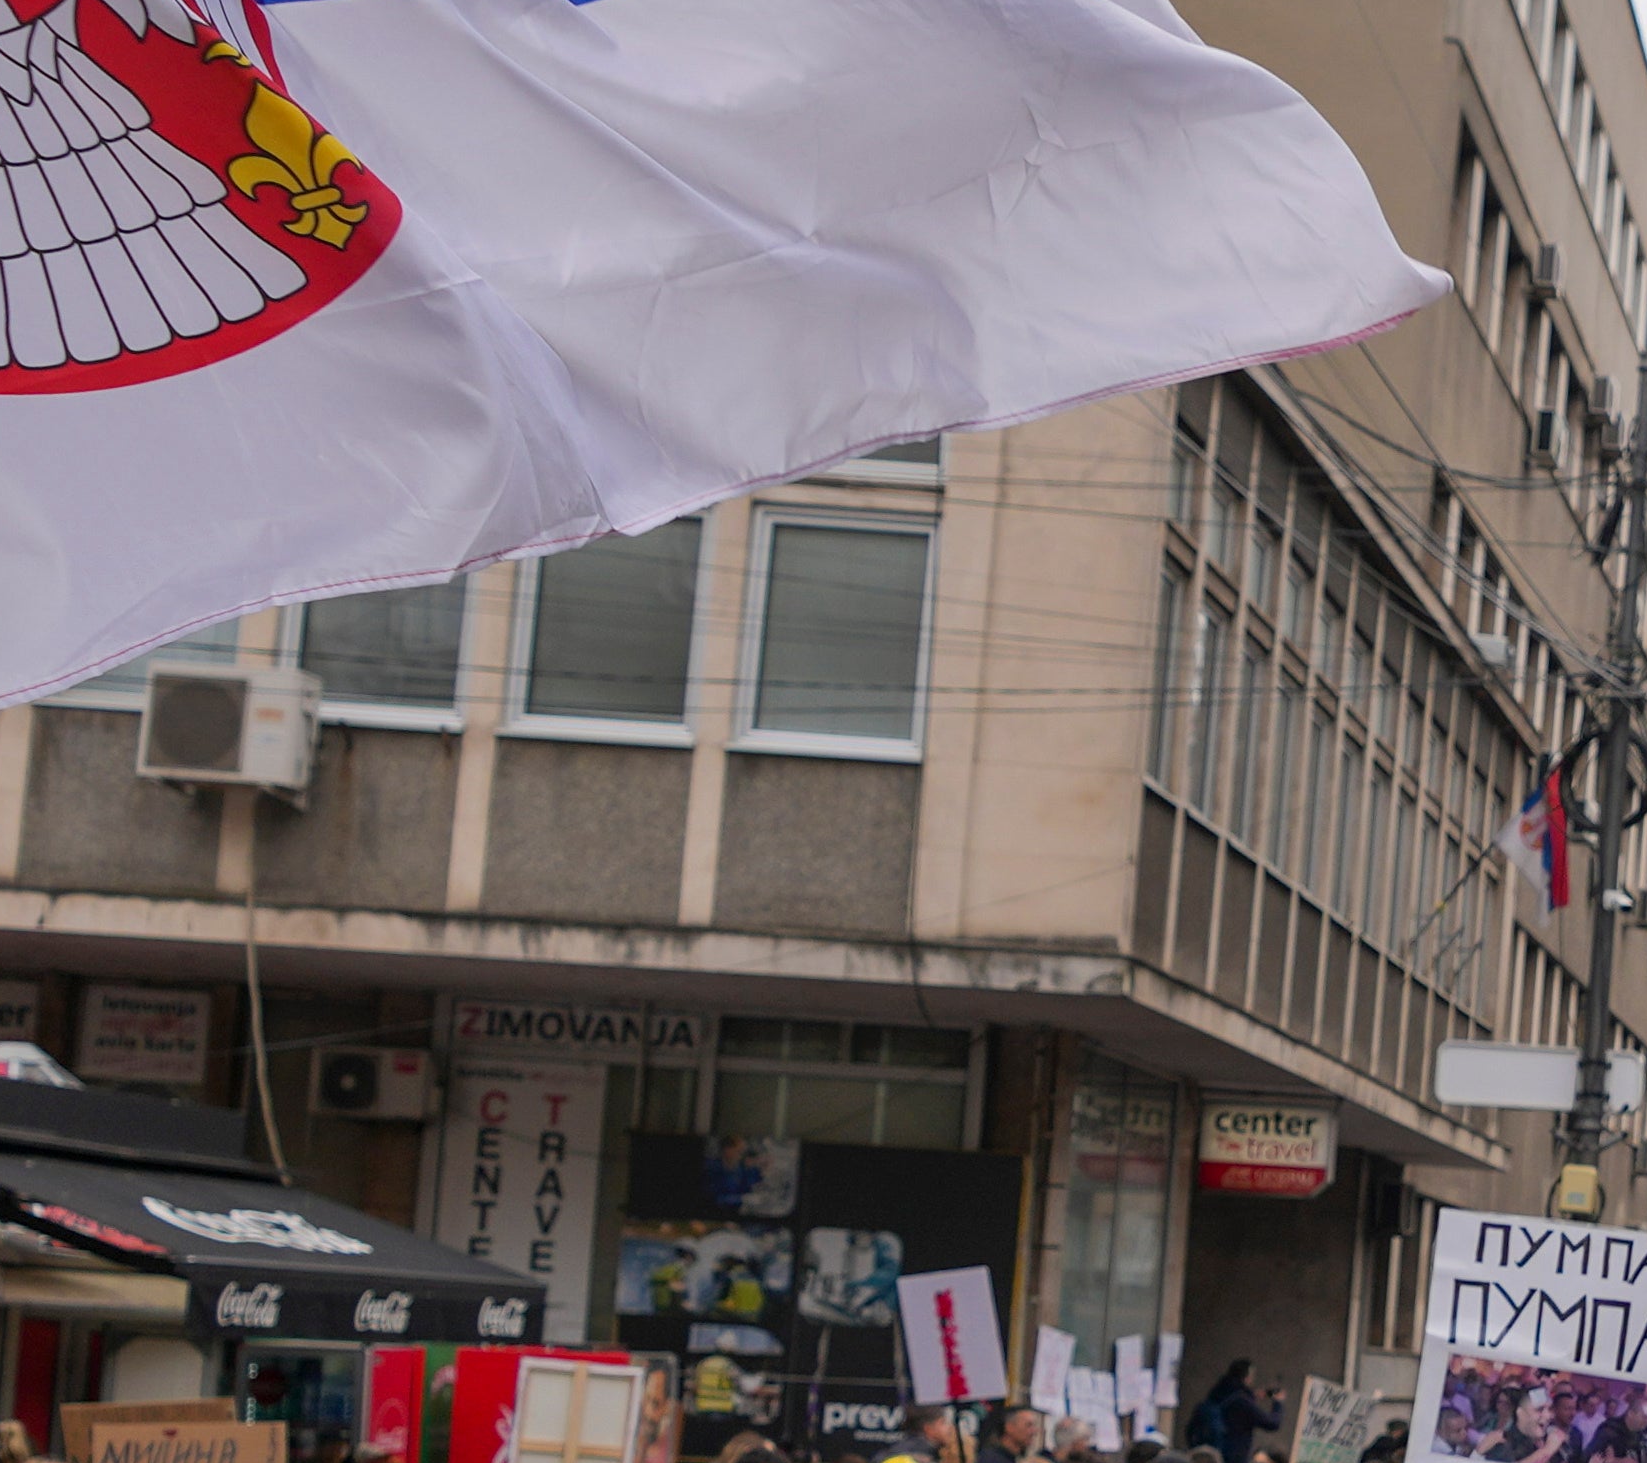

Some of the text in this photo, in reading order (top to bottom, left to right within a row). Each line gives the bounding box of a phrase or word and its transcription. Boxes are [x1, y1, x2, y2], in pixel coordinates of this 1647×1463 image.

[460, 1005, 695, 1048] ZIMOVANJA
[1214, 1108, 1318, 1137] center
[1246, 1136, 1316, 1163] travel
[468, 1088, 510, 1257] CENTE
